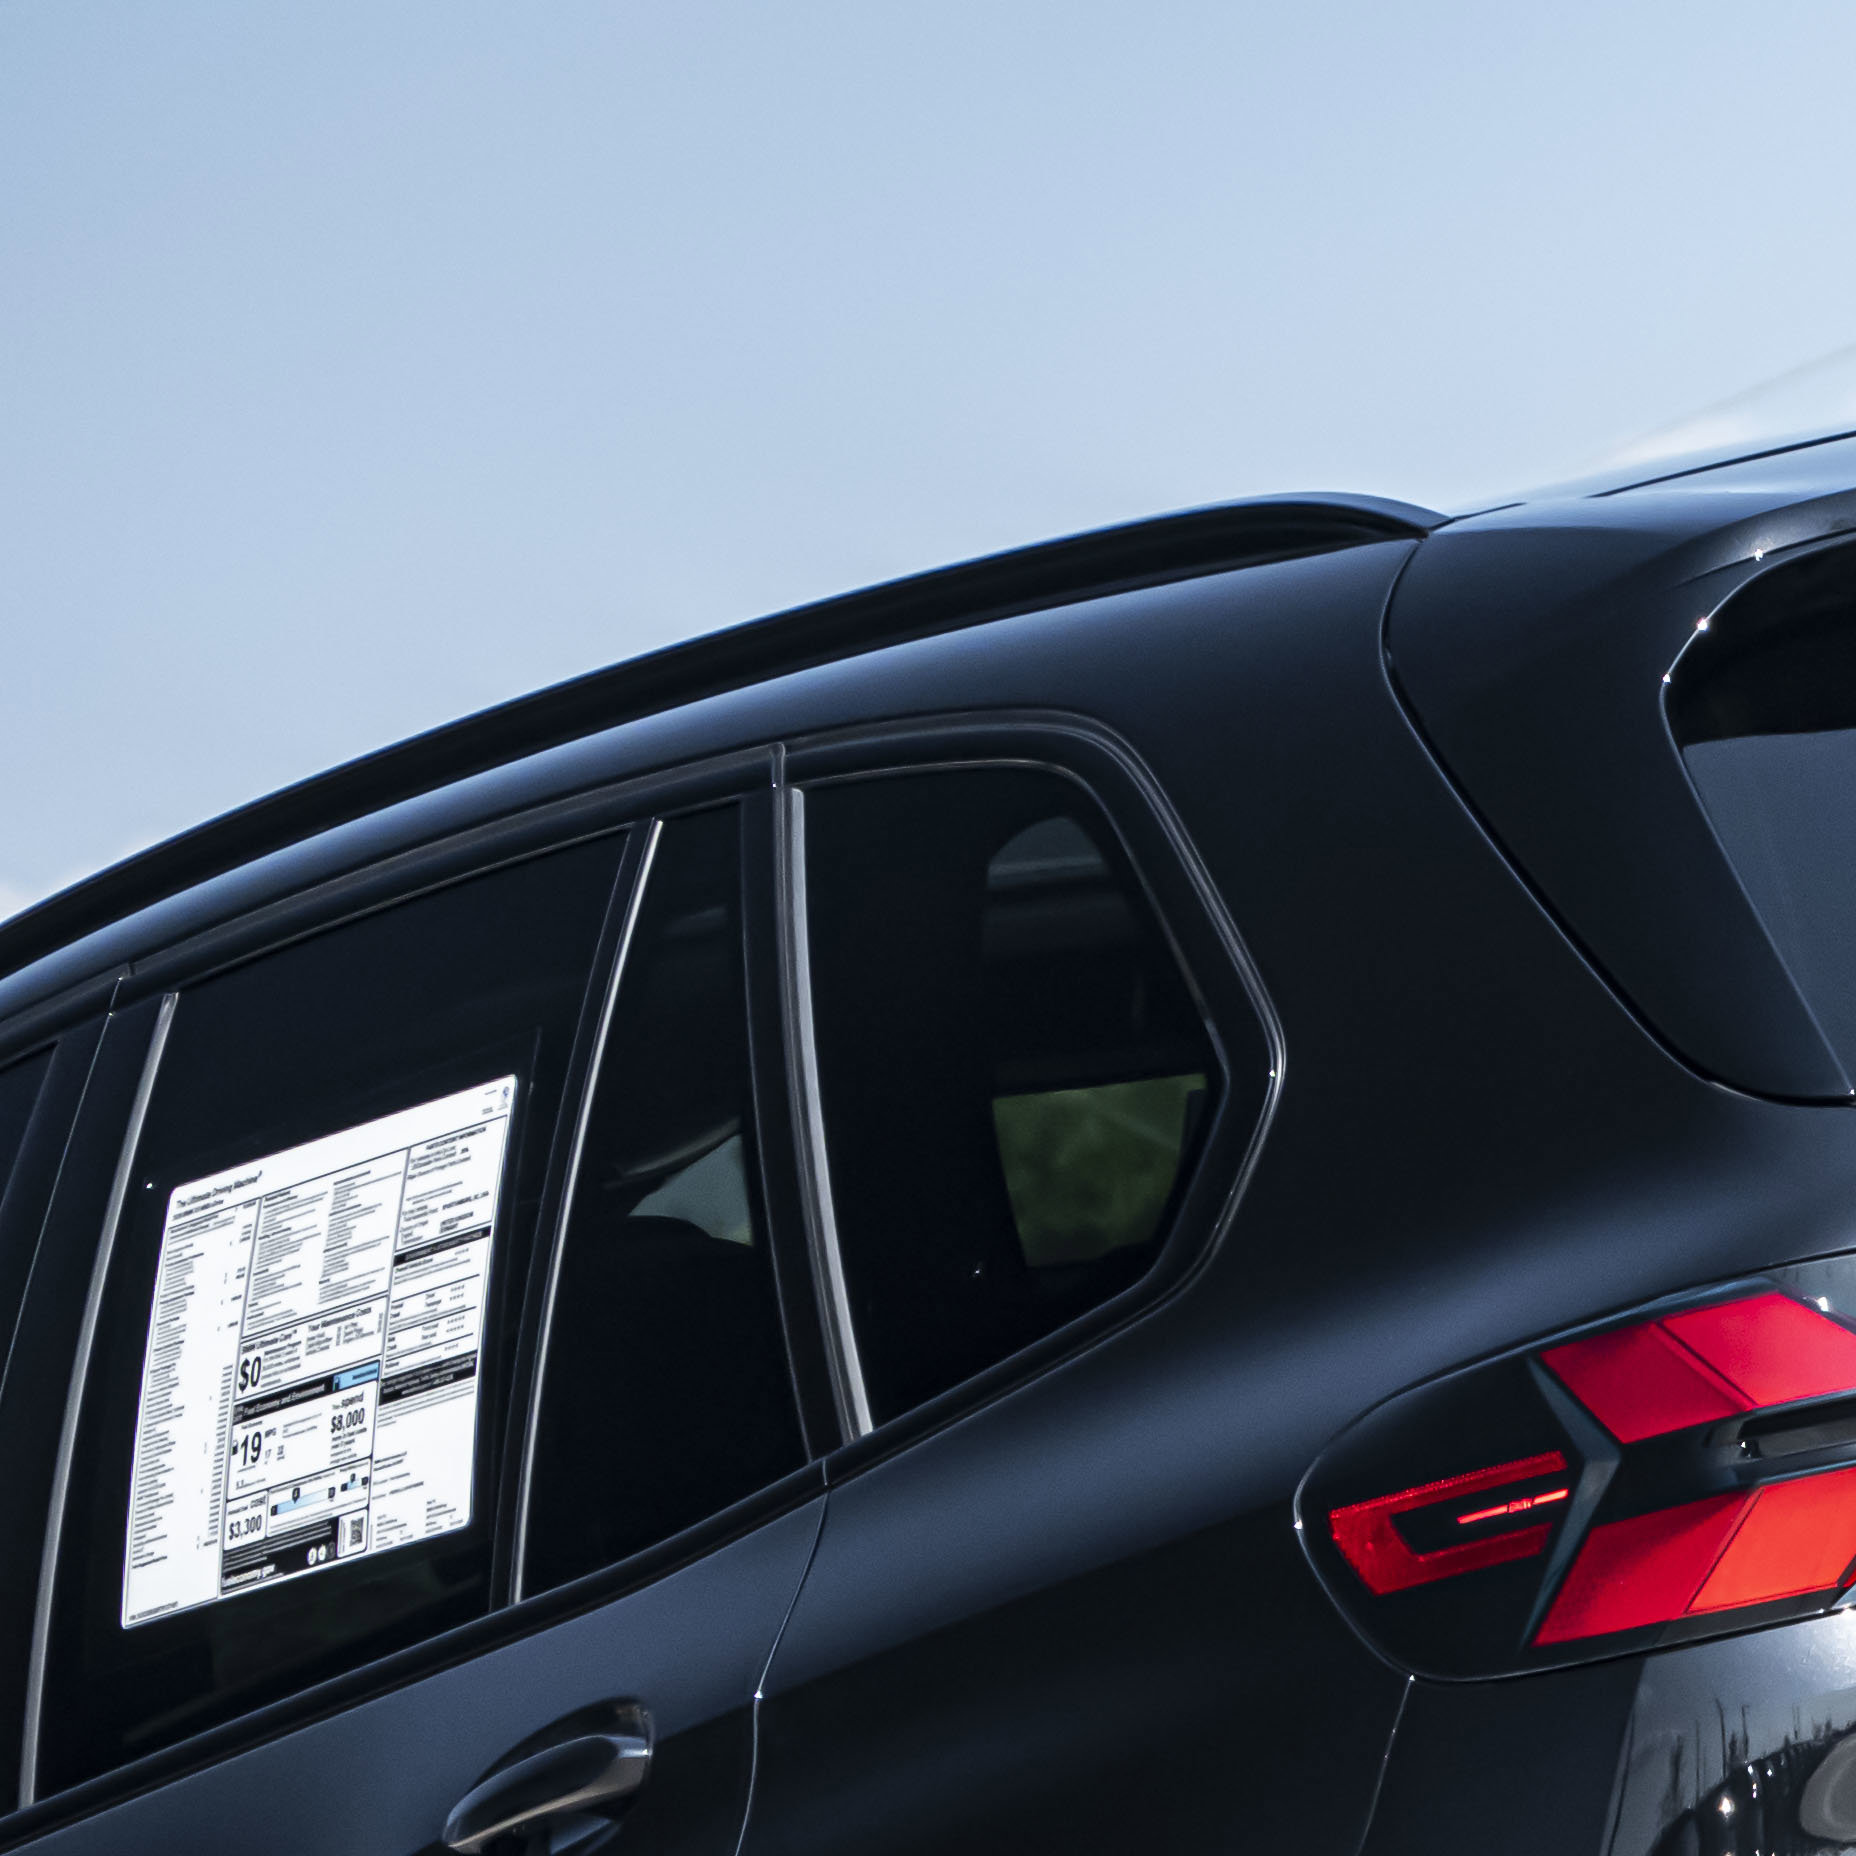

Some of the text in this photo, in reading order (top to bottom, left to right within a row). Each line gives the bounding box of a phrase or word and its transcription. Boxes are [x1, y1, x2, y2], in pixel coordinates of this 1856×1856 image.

[238, 1356, 262, 1393] $0
[329, 1407, 366, 1434] $8,000
[240, 1431, 262, 1467] 19
[228, 1514, 263, 1542] $3,300
